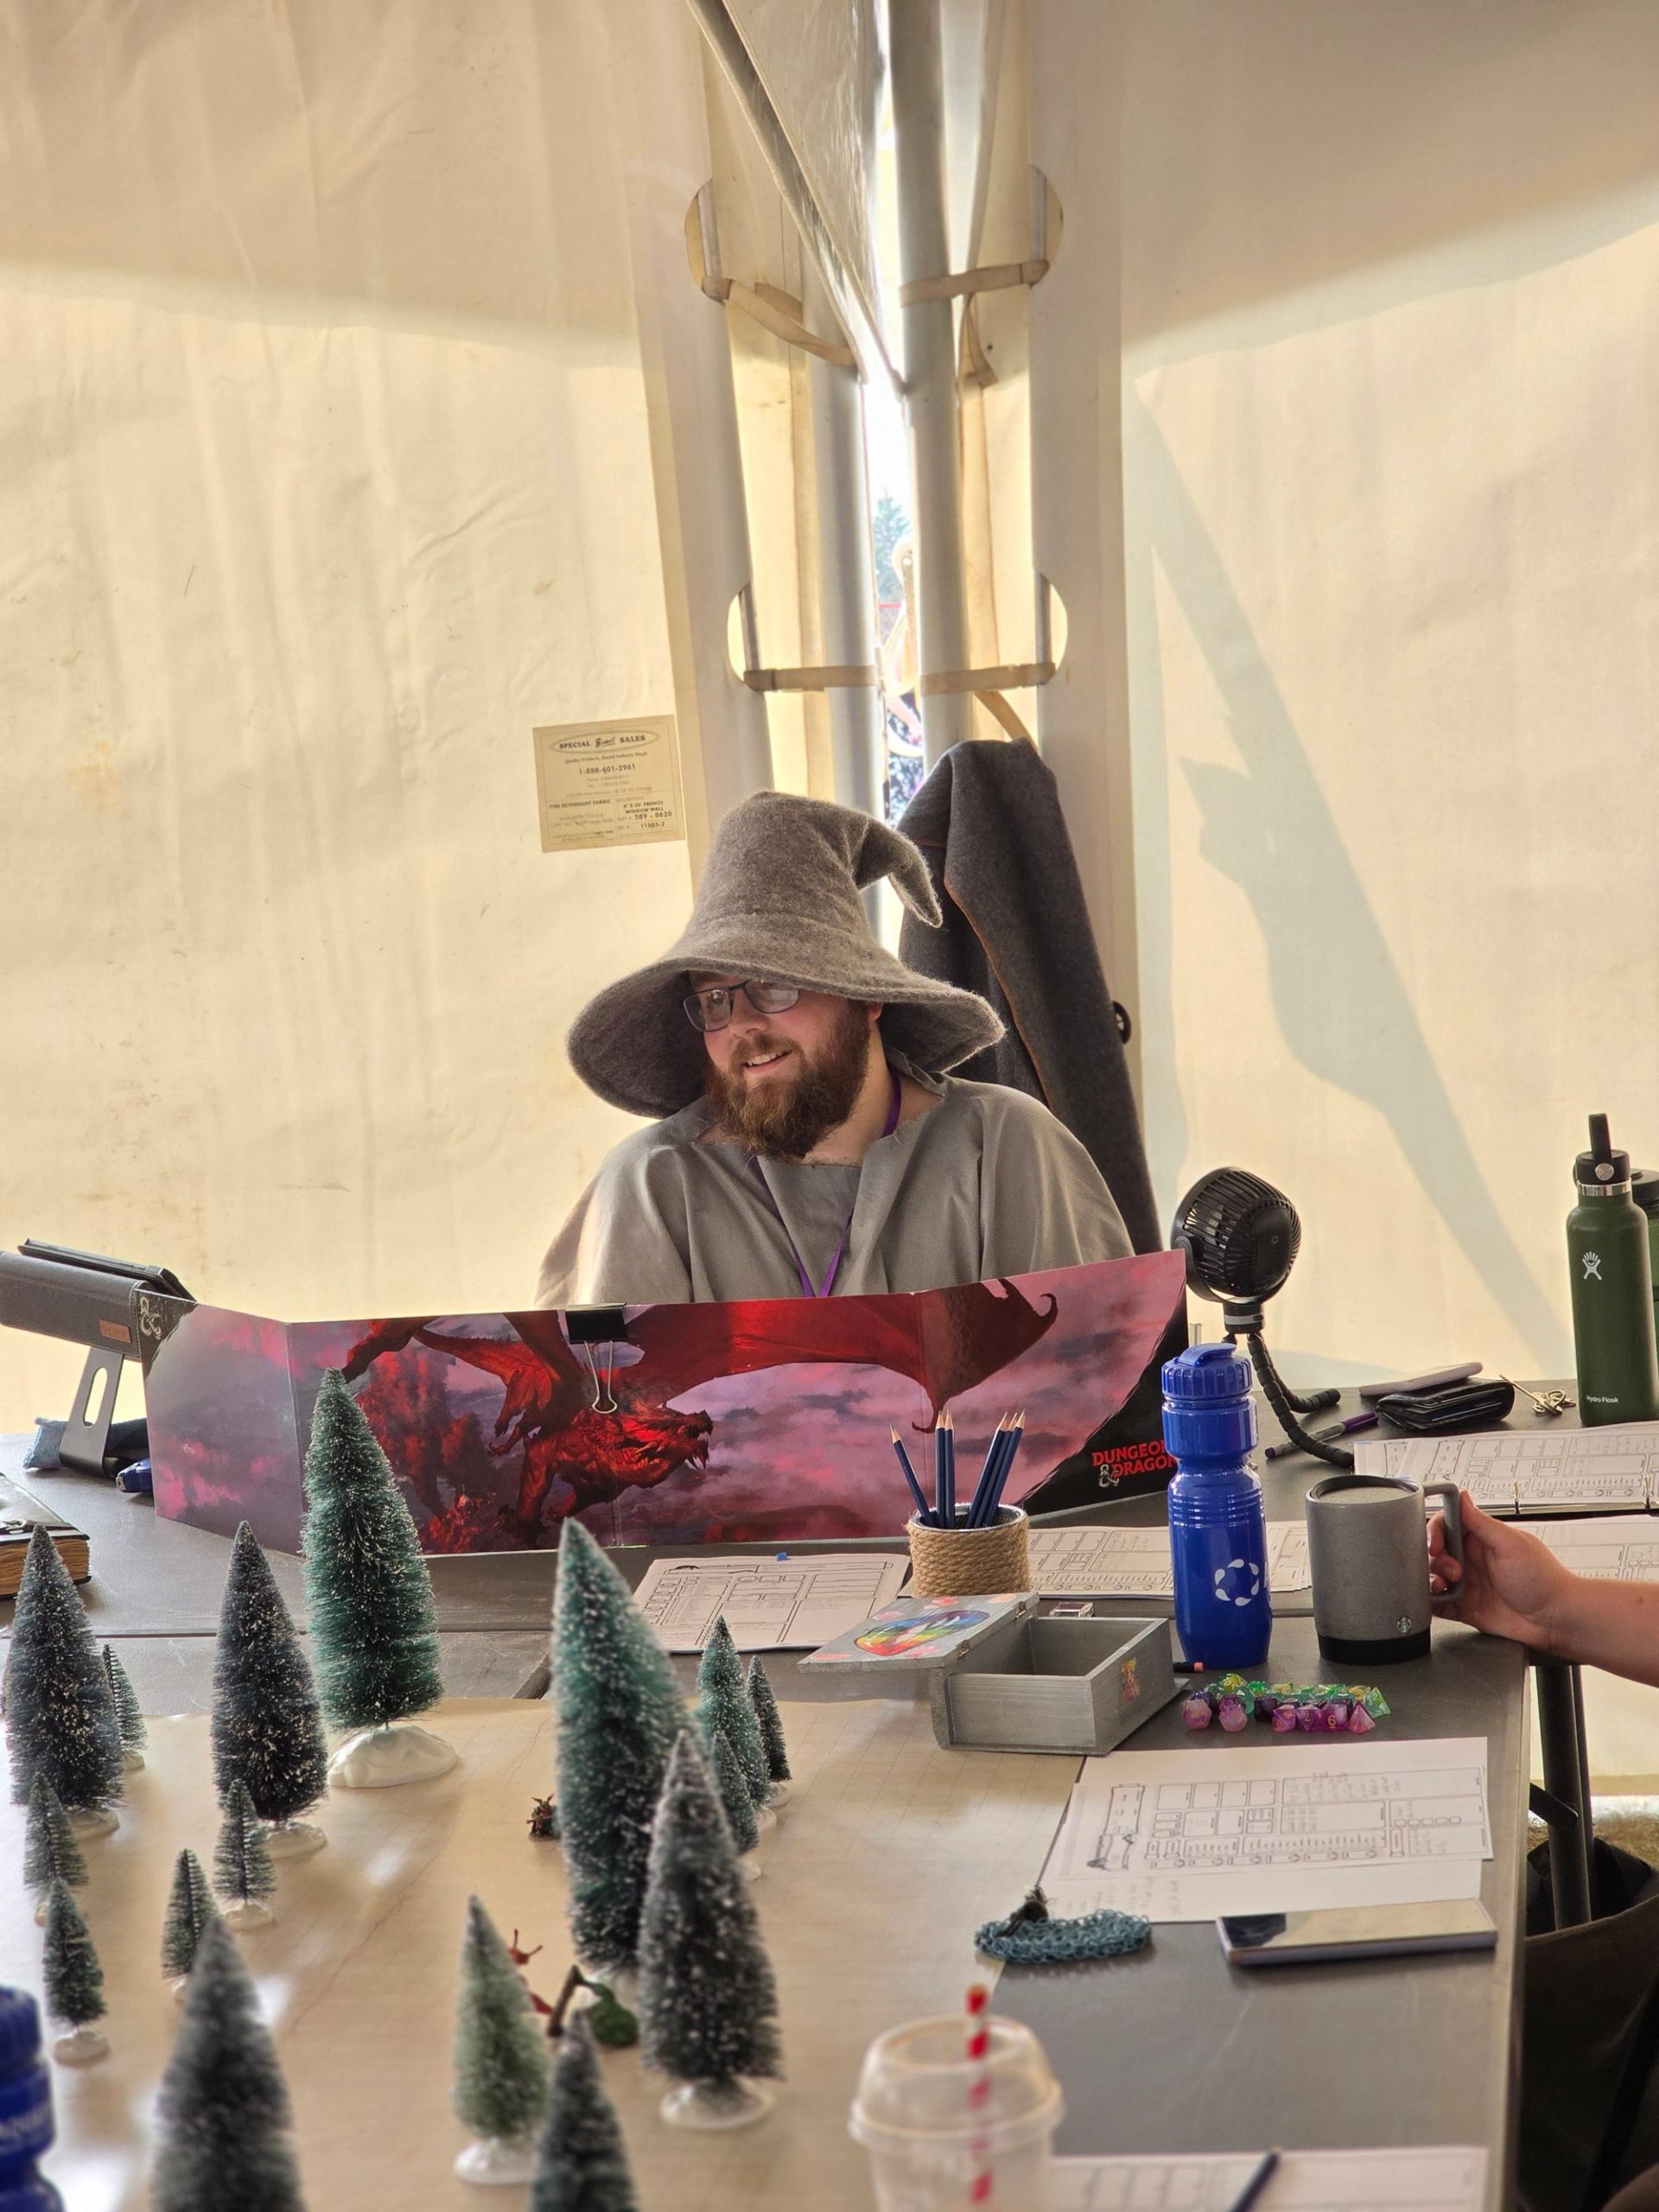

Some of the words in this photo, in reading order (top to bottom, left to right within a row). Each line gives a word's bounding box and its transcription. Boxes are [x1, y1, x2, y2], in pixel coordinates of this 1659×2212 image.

[559, 741, 591, 749] SPECIAL
[620, 734, 645, 743] SALES
[1586, 1395, 1601, 1403] Hydro
